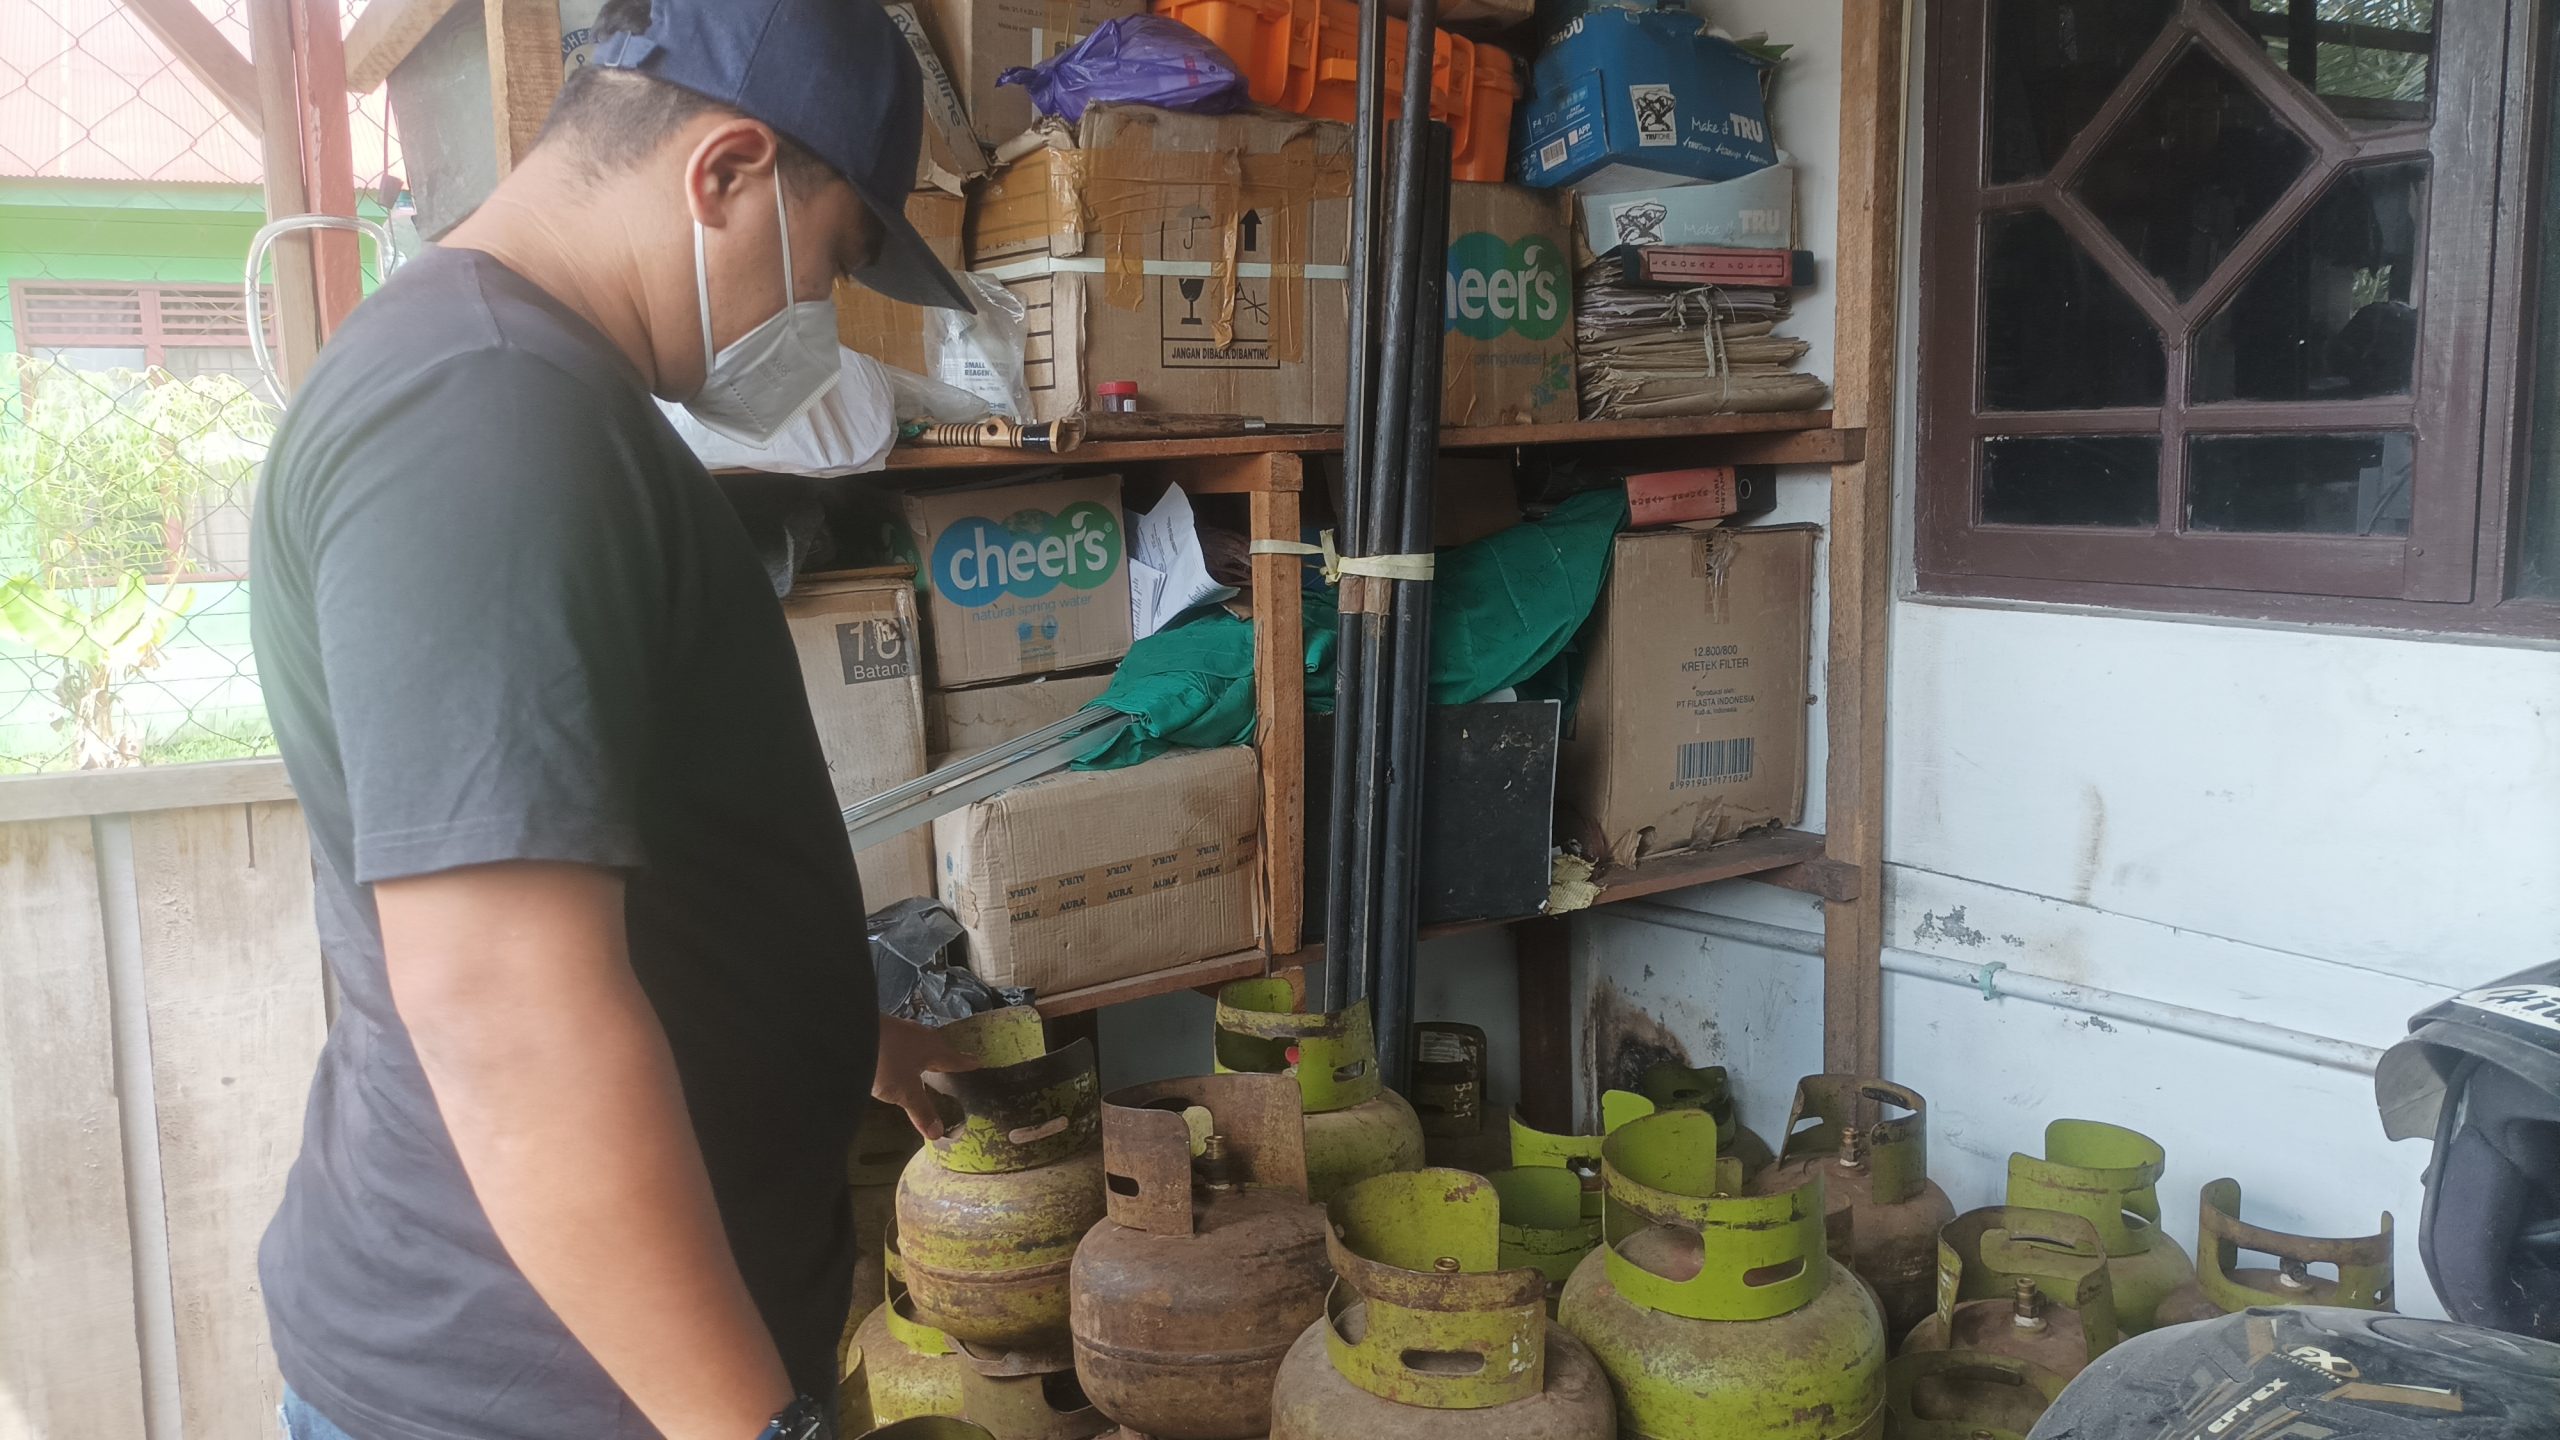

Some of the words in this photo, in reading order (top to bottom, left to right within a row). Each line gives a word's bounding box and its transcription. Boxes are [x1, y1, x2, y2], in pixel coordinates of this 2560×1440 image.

[1691, 116, 1720, 134] Make
[1729, 112, 1764, 144] TRU
[1645, 133, 1671, 141] TRUTONE
[1682, 222, 1720, 235] Make
[1739, 208, 1782, 234] TRU
[1652, 260, 1716, 270] LAPORAN
[1172, 347, 1200, 359] JANGAN
[951, 511, 1107, 590] cheers
[973, 606, 1015, 622] natural
[1020, 600, 1056, 615] spring
[1060, 595, 1092, 608] water
[1694, 645, 1738, 656] 12.800/800
[1682, 660, 1717, 672] KRETEK
[1720, 657, 1749, 669] FILTER
[1677, 700, 1686, 708] PT
[1687, 698, 1716, 708] FILASTA
[1718, 695, 1755, 706] INDONESIA
[1010, 908, 1040, 924] AURA
[1059, 896, 1087, 911] AURA
[1106, 885, 1134, 900] AURA
[1152, 875, 1179, 889] AURA
[1196, 864, 1221, 879] AURA
